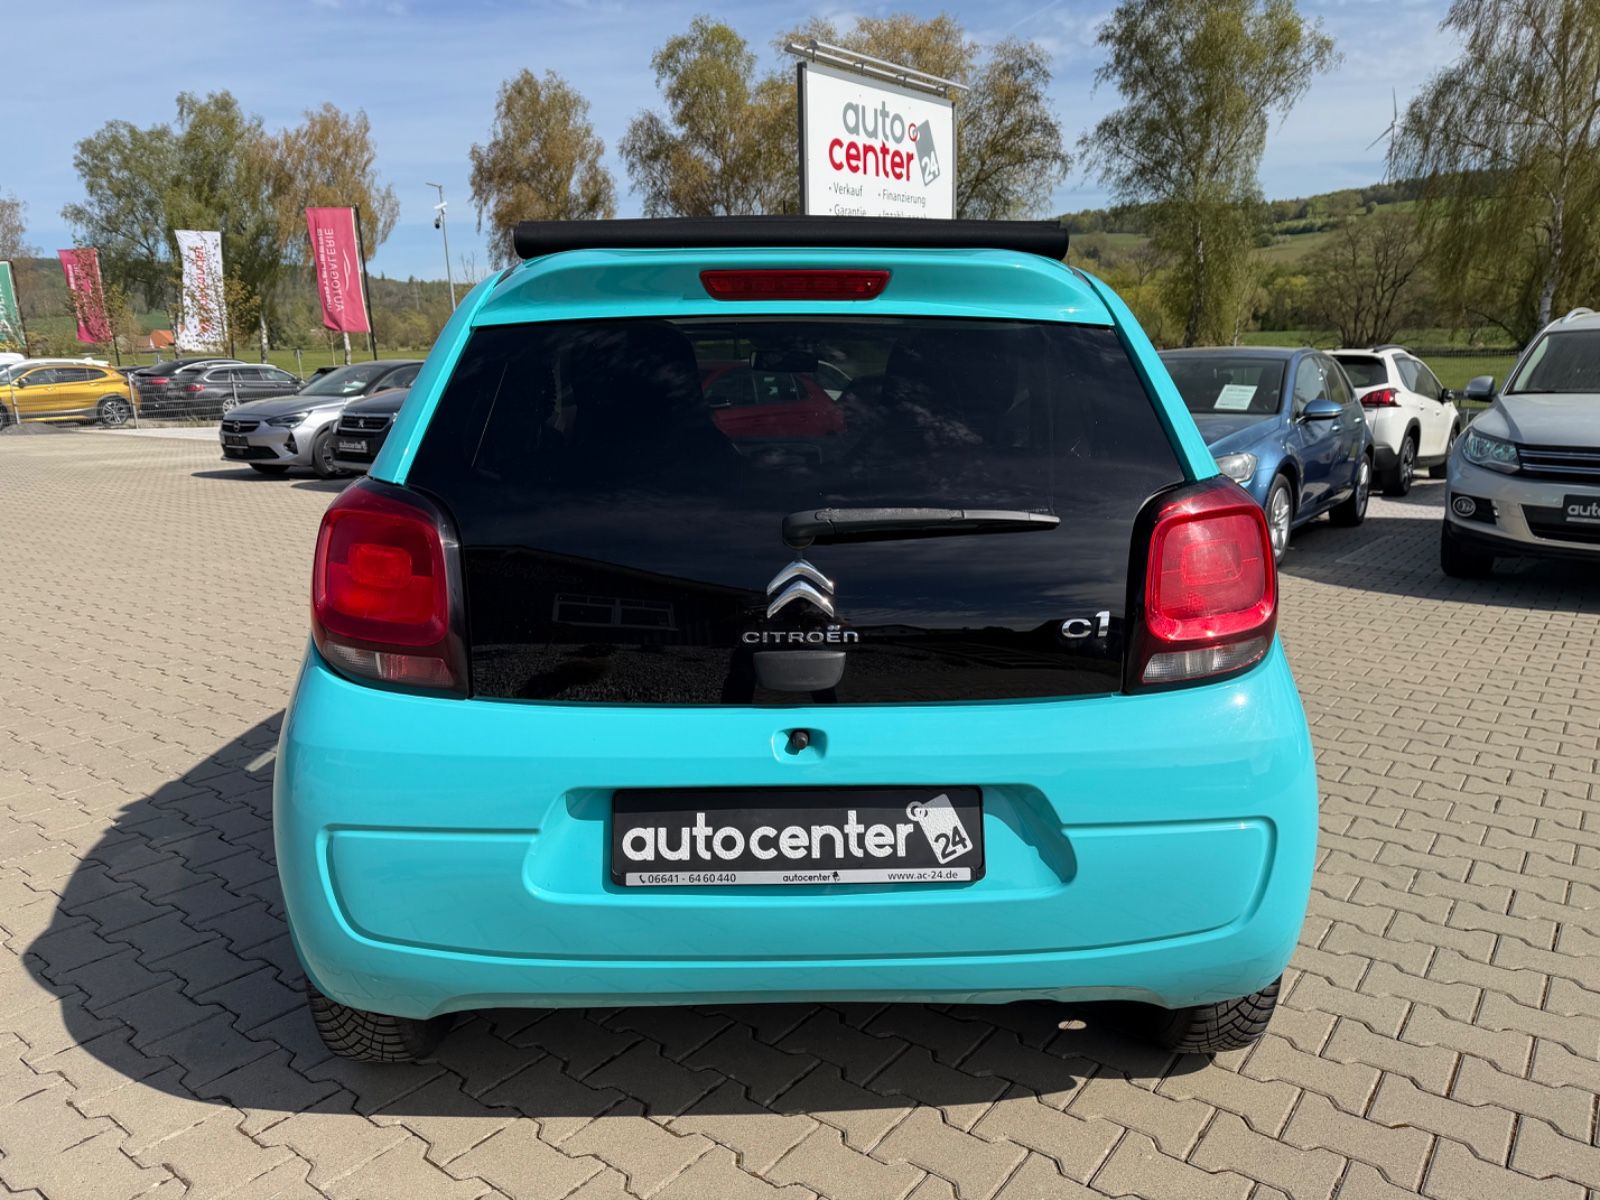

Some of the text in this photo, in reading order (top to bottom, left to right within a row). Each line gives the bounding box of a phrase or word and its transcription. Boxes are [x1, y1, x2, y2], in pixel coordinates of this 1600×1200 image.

[843, 100, 906, 144] auto
[828, 137, 914, 182] center
[921, 150, 939, 184] 24
[833, 181, 863, 197] Verkauf
[882, 188, 926, 208] Finanzierung
[741, 624, 860, 643] CITROËN
[1061, 611, 1110, 639] C1
[933, 824, 968, 859] 24
[648, 873, 679, 884] 06641
[782, 872, 831, 882] autocenter
[887, 870, 959, 881] www.ac-24.de
